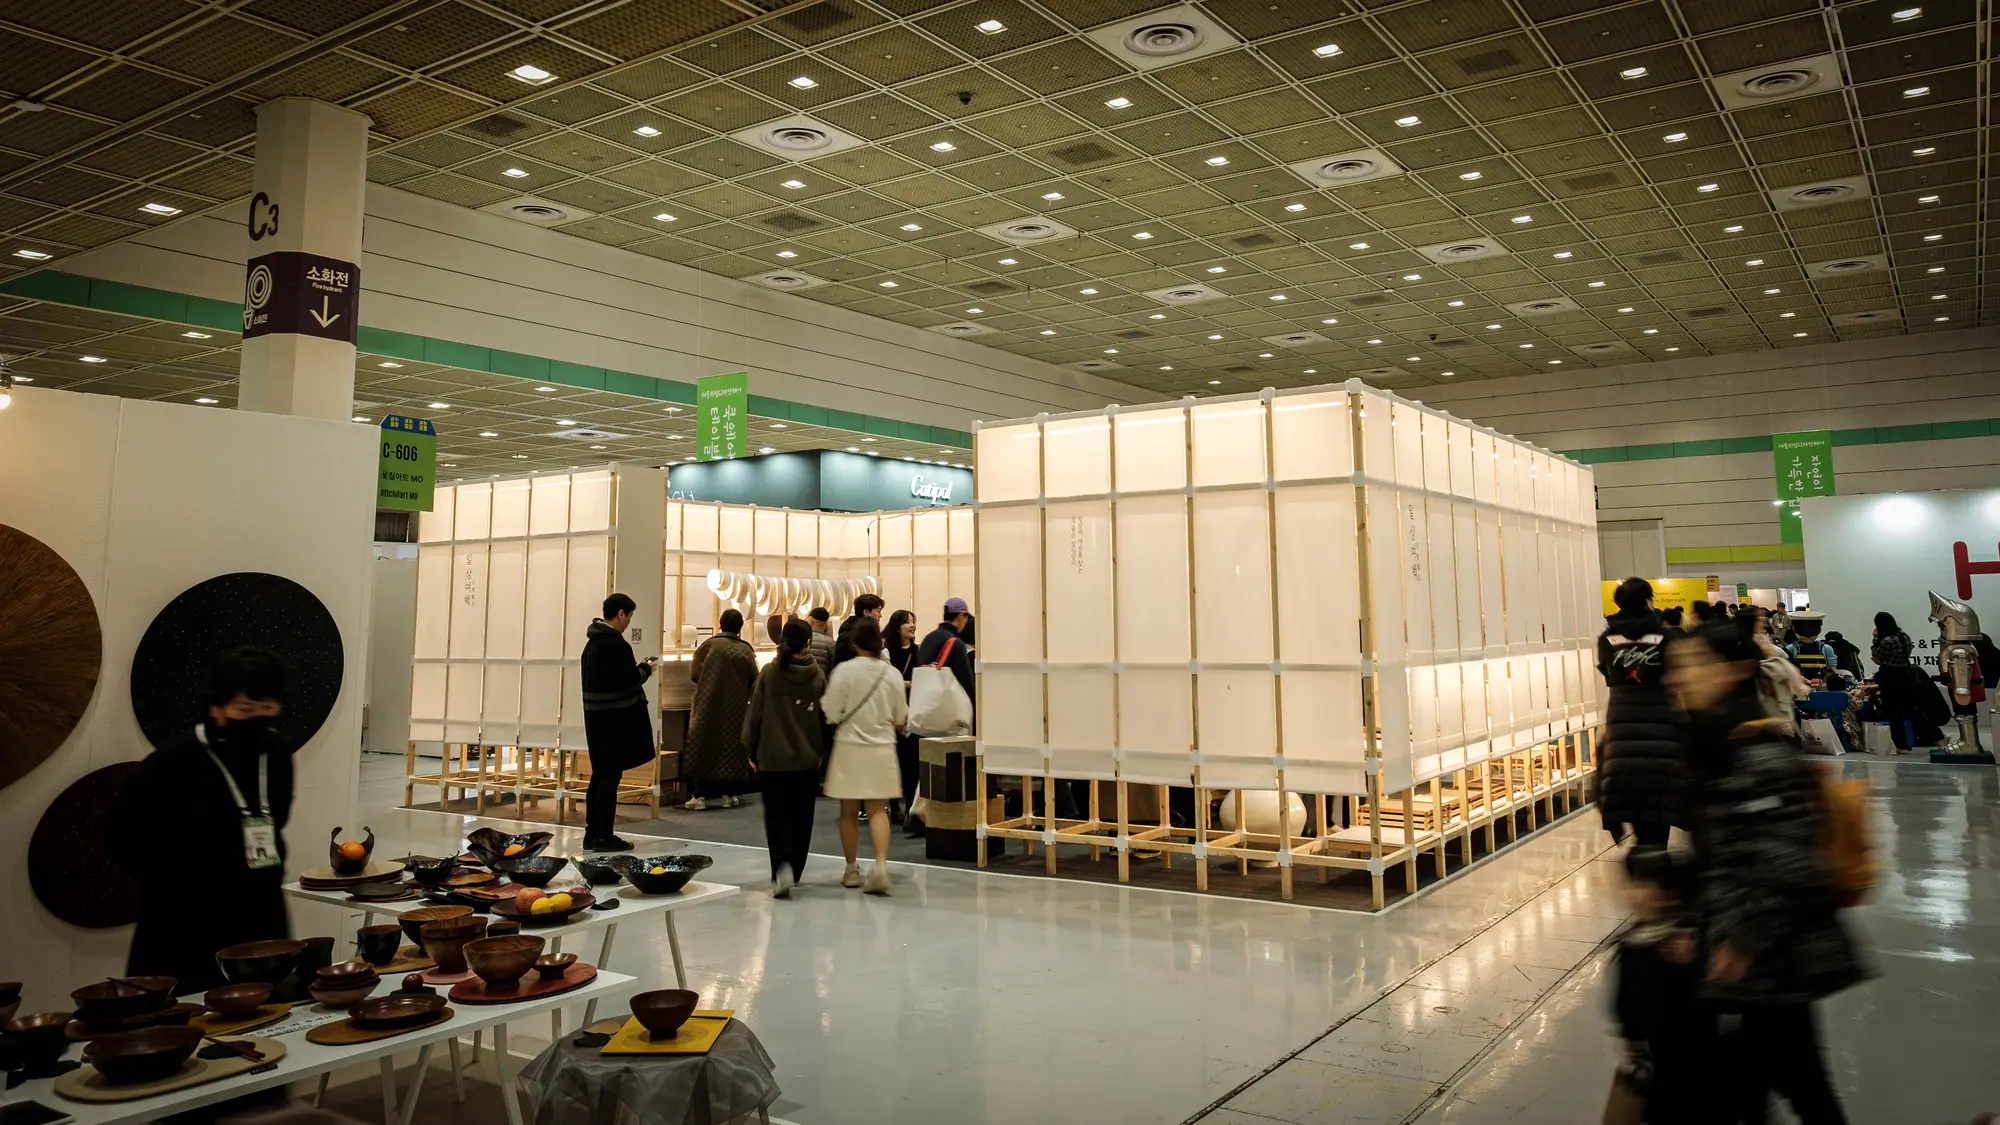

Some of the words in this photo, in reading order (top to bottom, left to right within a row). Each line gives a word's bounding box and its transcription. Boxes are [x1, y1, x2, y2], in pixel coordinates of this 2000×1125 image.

[248, 191, 280, 241] C3
[306, 265, 349, 288] 소화전
[312, 282, 323, 290] Fire
[323, 284, 342, 293] hydrant
[703, 407, 721, 458] 테이블
[722, 404, 737, 459] 쿡웨어
[383, 442, 418, 462] C-606
[381, 470, 409, 482] 옻칠아트
[410, 475, 424, 484] MO
[1788, 455, 1805, 492] 가득한
[1806, 455, 1823, 490] 자연이
[1918, 639, 1928, 649] &
